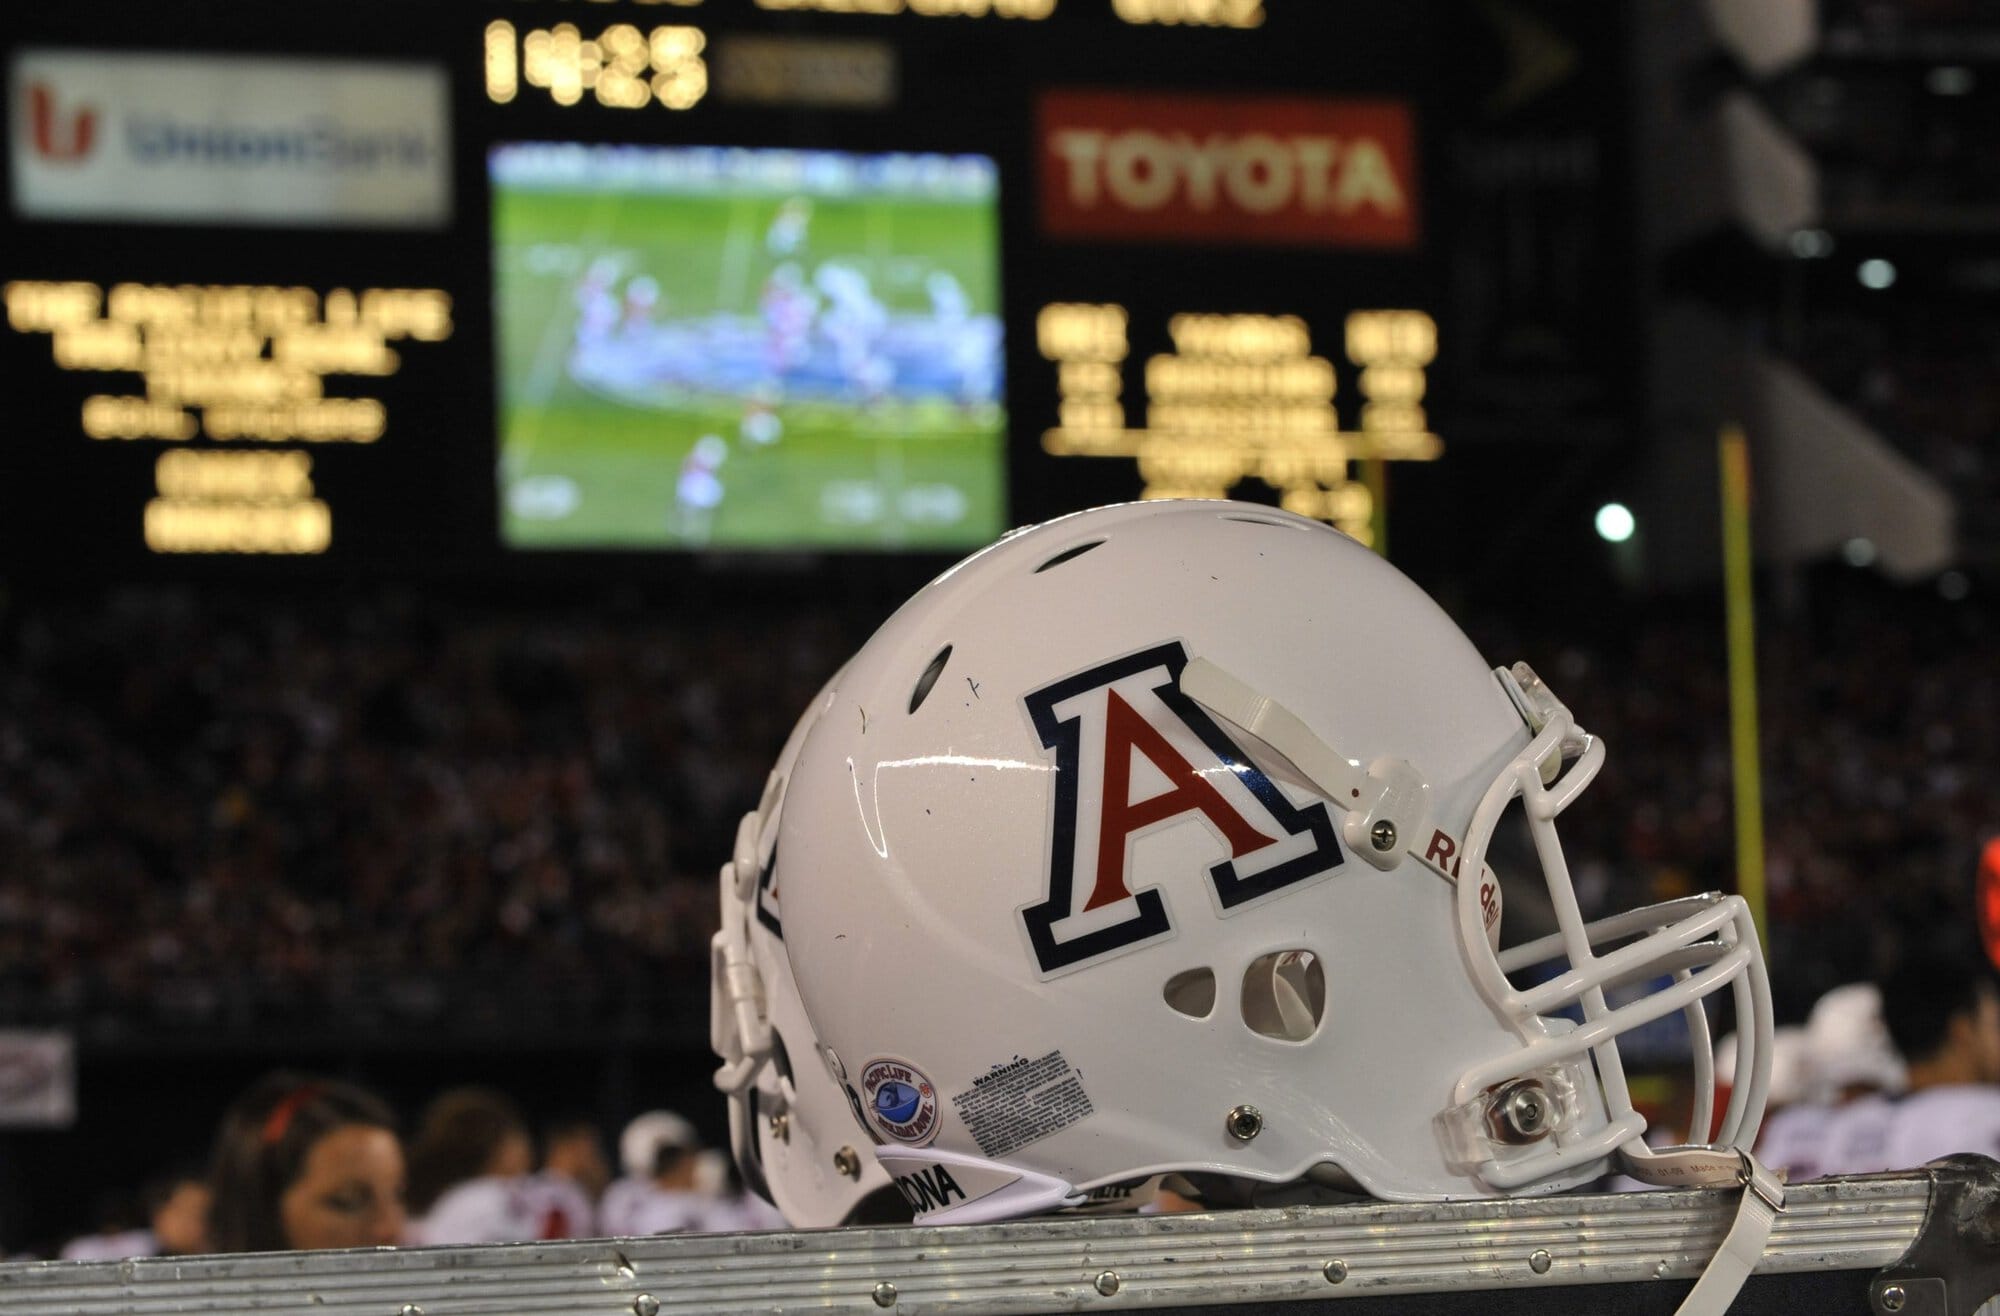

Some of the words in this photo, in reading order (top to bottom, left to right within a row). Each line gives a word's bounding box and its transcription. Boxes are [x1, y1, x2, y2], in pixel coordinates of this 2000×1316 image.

[1052, 130, 1402, 215] TOYOTA
[1023, 641, 1344, 973] A
[973, 1058, 1029, 1087] WARNING
